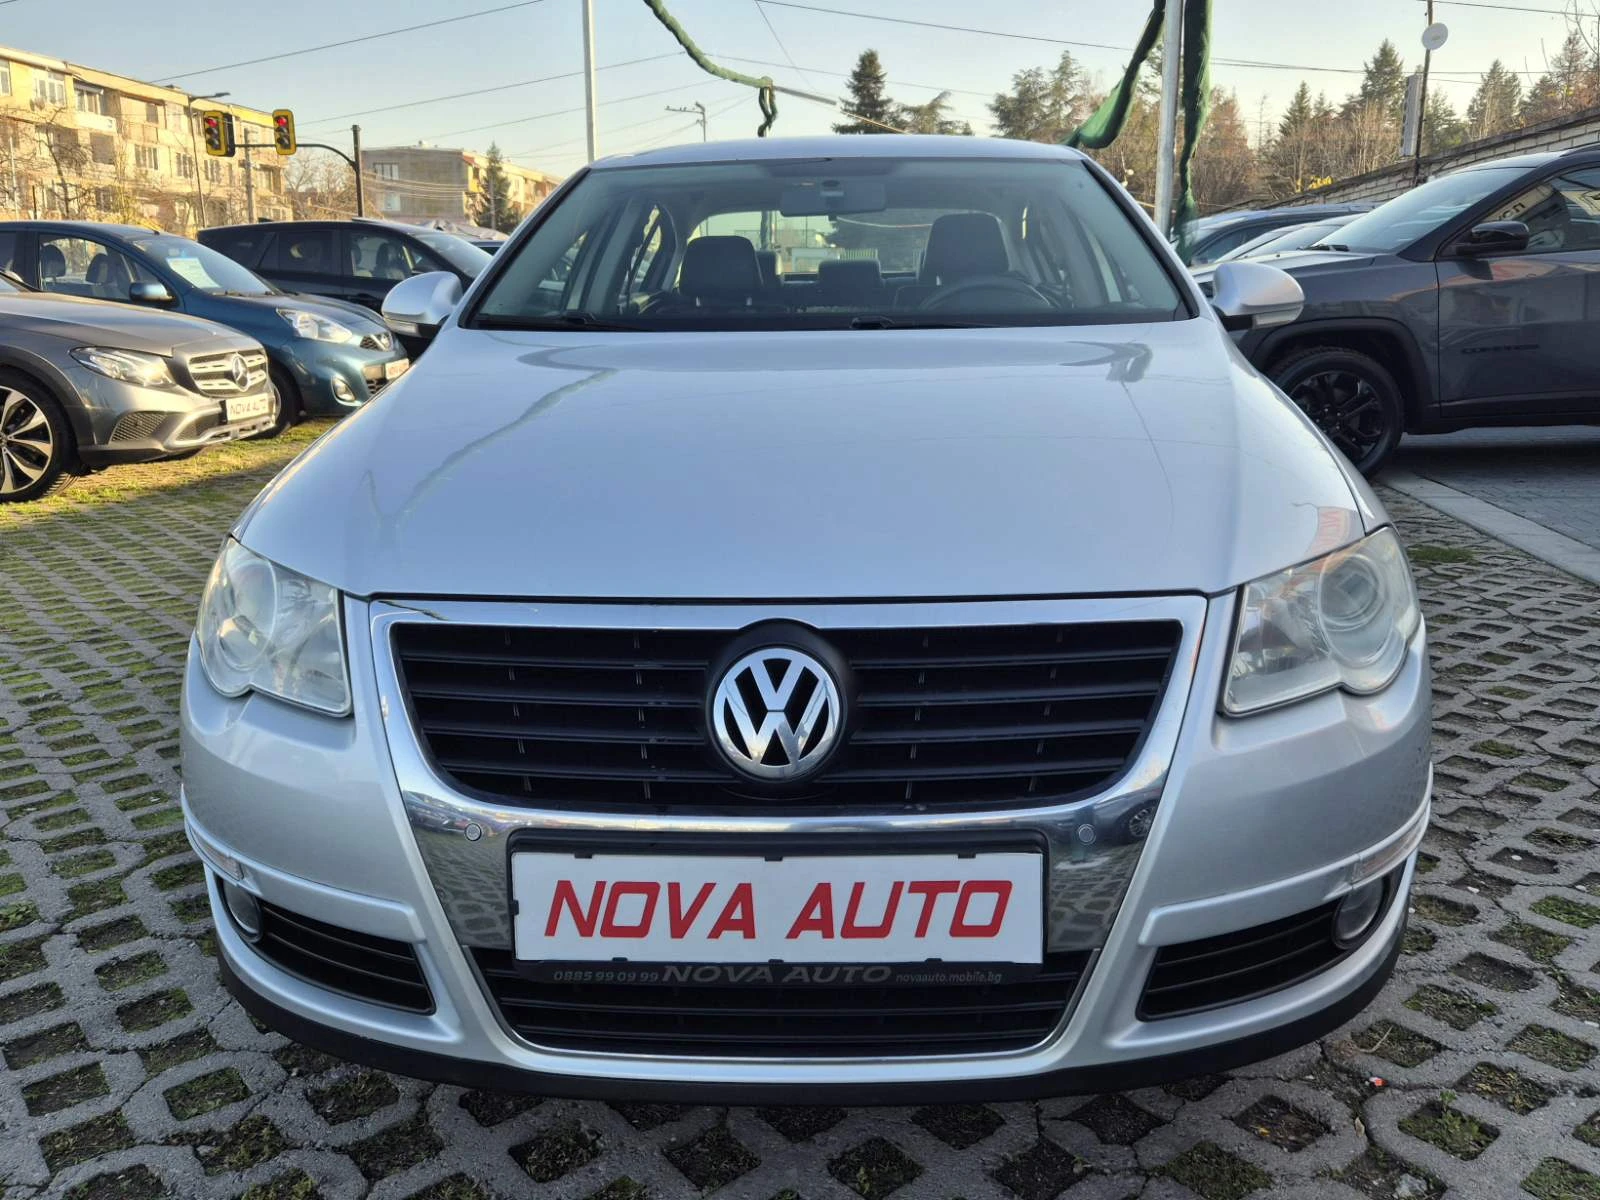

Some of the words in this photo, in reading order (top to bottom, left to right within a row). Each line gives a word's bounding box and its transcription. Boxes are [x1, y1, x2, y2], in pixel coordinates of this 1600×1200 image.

[544, 879, 756, 940] NOVA
[785, 879, 1013, 940] AUTO
[553, 970, 593, 982] 0885
[595, 970, 615, 982] 99
[617, 971, 636, 983] 09
[640, 971, 659, 983] 99
[662, 965, 774, 983] NOVA
[782, 965, 892, 983] AUTO
[896, 971, 1002, 984] novaauto.mobile.bg
